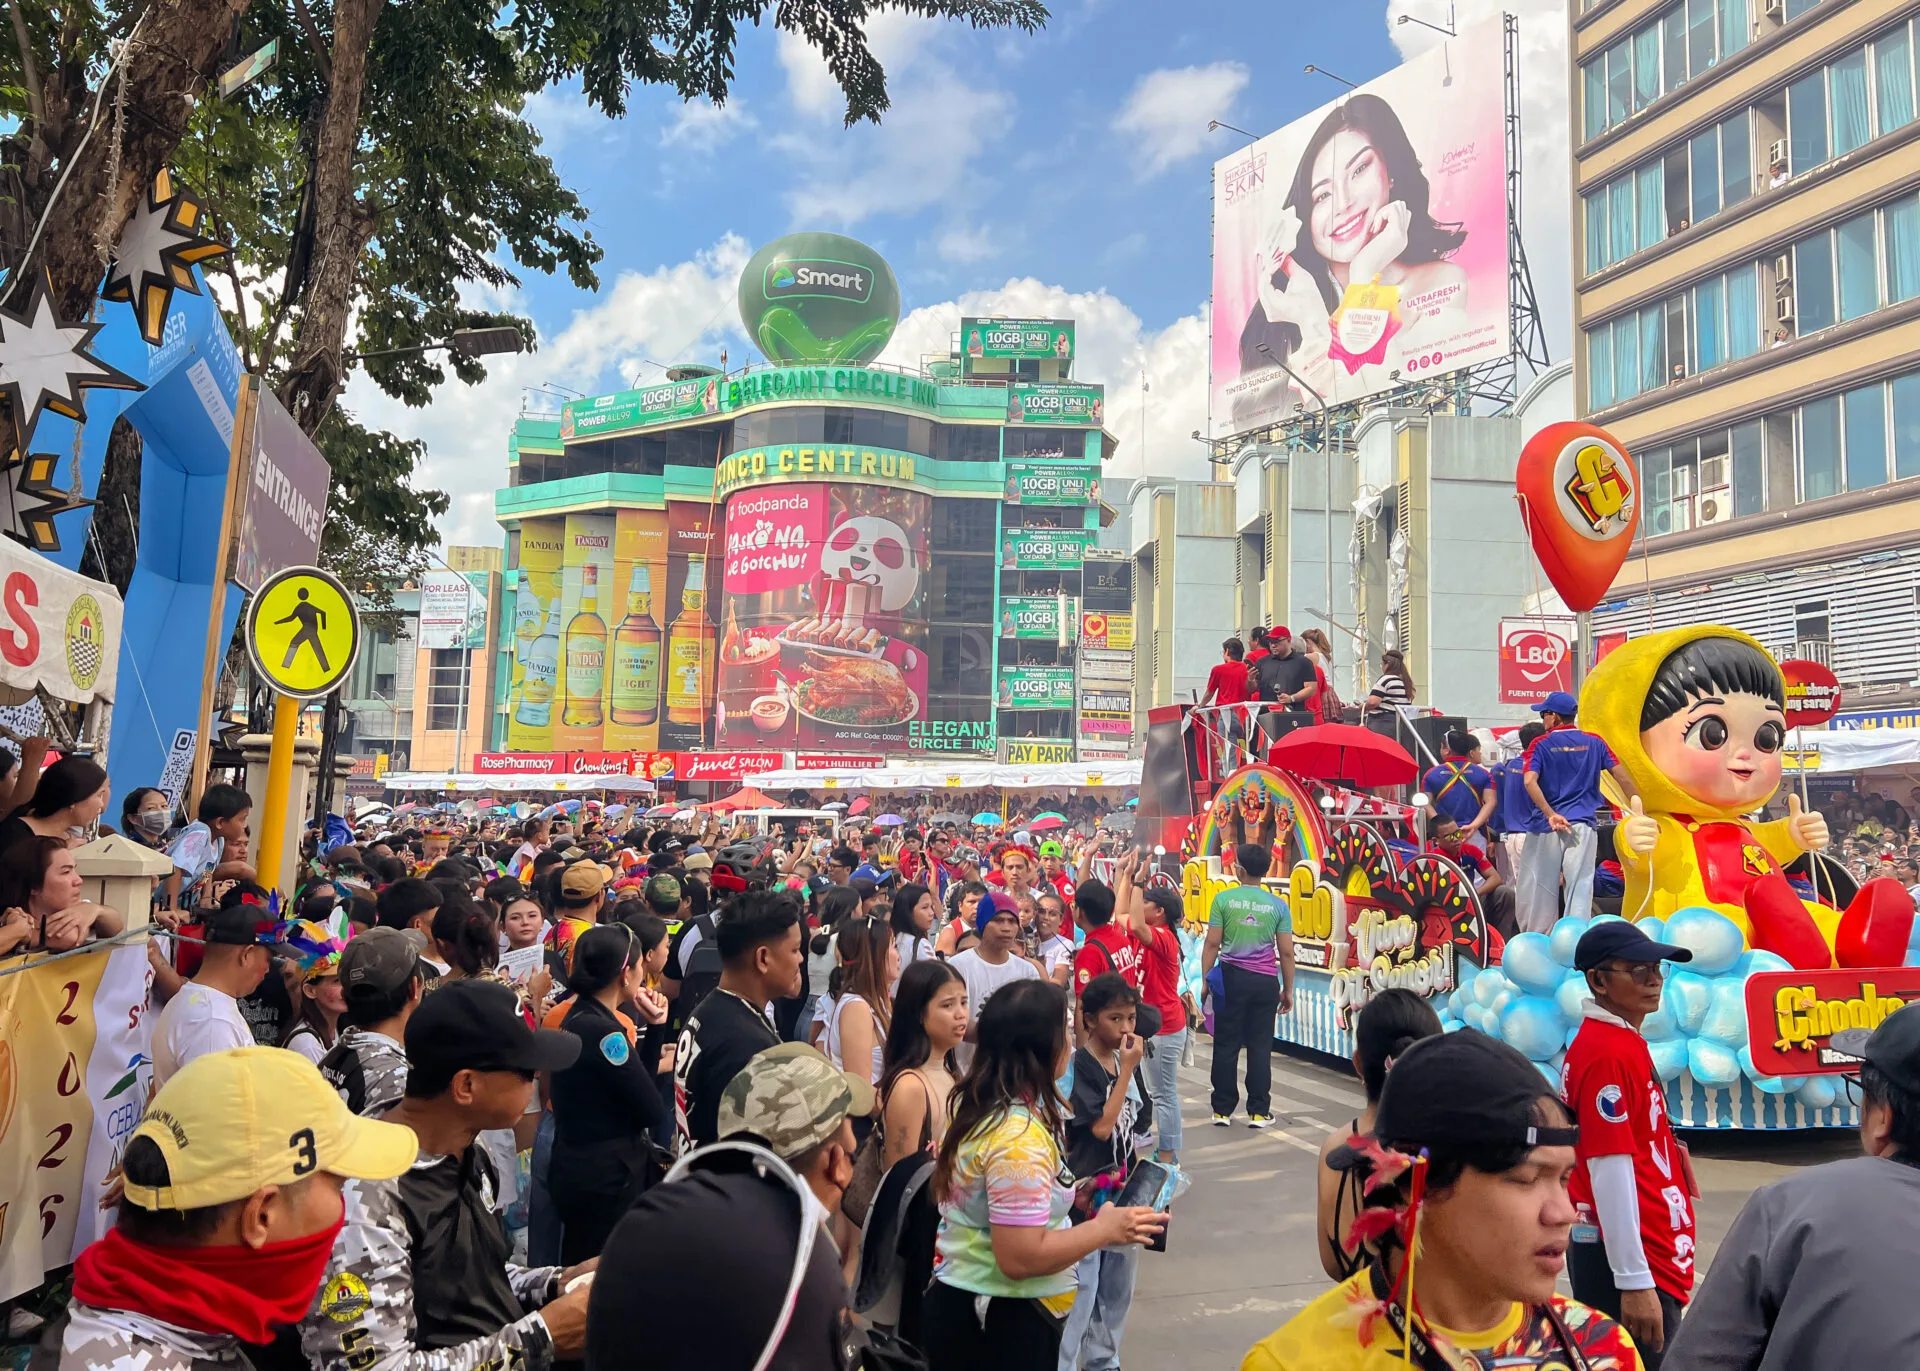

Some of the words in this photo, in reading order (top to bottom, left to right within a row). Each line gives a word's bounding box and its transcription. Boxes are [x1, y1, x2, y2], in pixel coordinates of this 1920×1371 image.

[1225, 167, 1265, 201] SKIN
[797, 267, 863, 291] Smart
[1406, 283, 1461, 308] ULTRAFRESH
[1416, 297, 1451, 312] SUNSCREEN
[987, 332, 1020, 344] 10GB
[1026, 333, 1047, 341] UNLI
[676, 384, 697, 396] UNLI
[743, 370, 826, 399] ELEGANT
[834, 370, 907, 399] CIRCLE
[911, 380, 937, 408] INN
[1225, 383, 1248, 396] TINTED
[641, 387, 672, 406] 10GB
[1025, 396, 1058, 408] 10GB
[1064, 398, 1086, 406] UNLI
[645, 404, 654, 412] OF
[653, 403, 666, 411] DATA
[718, 452, 767, 486] CINCO
[778, 449, 915, 481] CENTRUM
[1022, 478, 1056, 490] 10GB
[1062, 480, 1084, 488] UNLI
[255, 448, 319, 543] ENTRANCE
[738, 493, 809, 516] foodpanda
[576, 535, 608, 547] TANDUAY
[677, 530, 716, 540] TANDUAY
[774, 525, 811, 549] NA,
[524, 541, 564, 550] TANDUAY
[1018, 542, 1052, 554] 10GB
[1058, 544, 1079, 552] UNLI
[424, 584, 442, 592] FOR
[443, 584, 471, 592] LEASE
[1018, 612, 1051, 624] 10GB
[1516, 646, 1557, 665] LBC
[528, 661, 556, 674] TANDUA
[620, 680, 652, 688] LIGHT
[1014, 680, 1048, 692] 10GB
[1054, 682, 1074, 690] UNL
[1508, 690, 1535, 698] FUENTE
[1096, 696, 1130, 712] INNOVATIVE
[908, 720, 997, 737] ELEGANT
[908, 738, 962, 750] CIRCLE
[972, 738, 997, 750] INN
[1008, 744, 1033, 762] PAY
[1036, 744, 1074, 763] PARK
[574, 756, 622, 774] Chowking
[686, 756, 736, 778] juvel
[738, 758, 774, 769] SALON
[1348, 908, 1417, 970] Viva
[1330, 966, 1371, 1029] Pit
[290, 1127, 317, 1176] 3
